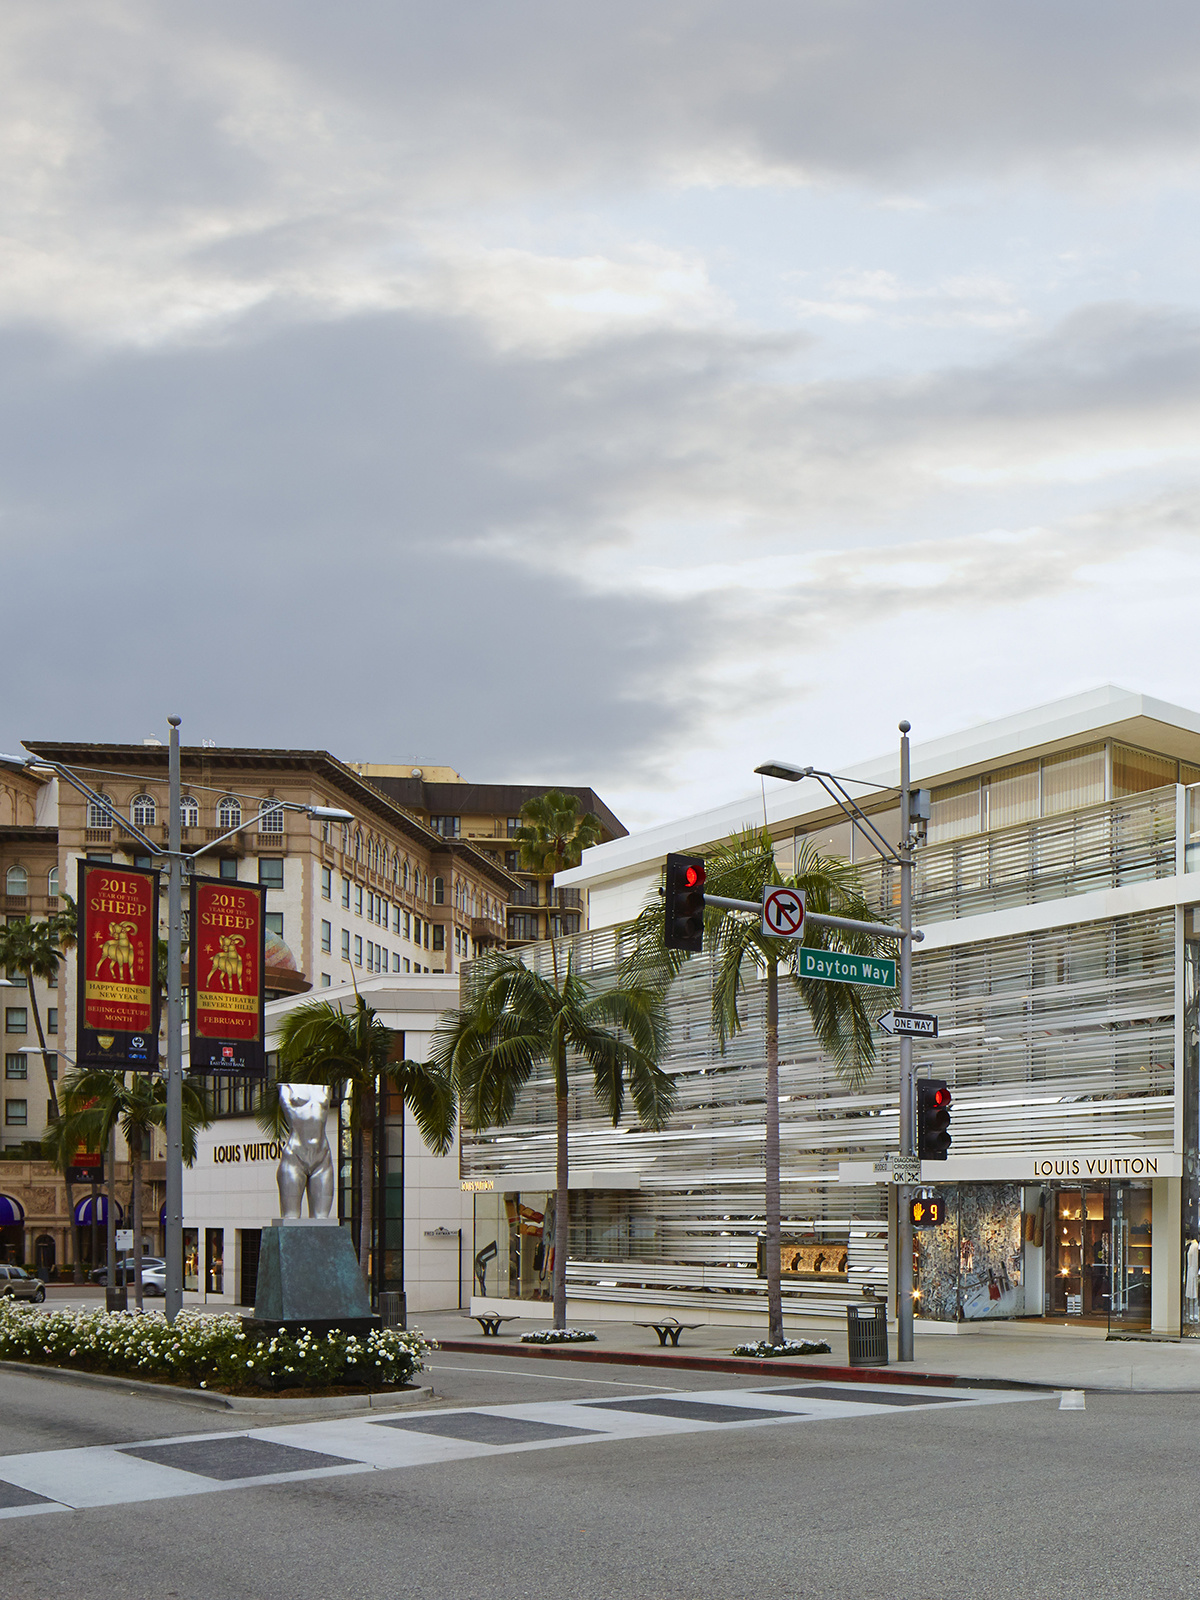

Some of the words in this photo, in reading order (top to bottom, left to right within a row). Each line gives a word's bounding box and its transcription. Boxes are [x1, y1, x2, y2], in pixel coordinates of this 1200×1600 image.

[100, 878, 137, 895] 2015
[90, 898, 147, 917] SHEEP
[211, 893, 246, 909] 2015
[201, 912, 255, 930] SHEEP
[806, 955, 858, 977] Dayton
[862, 963, 889, 984] Way
[89, 983, 115, 992] HAPPY
[115, 986, 148, 995] CHINESE
[99, 991, 117, 999] NEW
[118, 993, 139, 1001] YEAR
[199, 993, 224, 1001] SABAN
[225, 996, 257, 1005] THEATRE
[87, 1005, 116, 1014] BEIJING
[116, 1008, 149, 1017] CULTURE
[202, 1001, 233, 1010] BEVERLY
[234, 1003, 254, 1011] HILLS
[104, 1014, 133, 1023] MONTH
[204, 1016, 246, 1026] FEBRUARY
[894, 1018, 912, 1029] ONE
[914, 1020, 932, 1031] WAY
[213, 1144, 241, 1164] LOUIS
[1034, 1159, 1080, 1176] LOUIS
[1086, 1157, 1158, 1174] VUITTON
[893, 1172, 904, 1182] OK
[930, 1204, 938, 1221] 9
